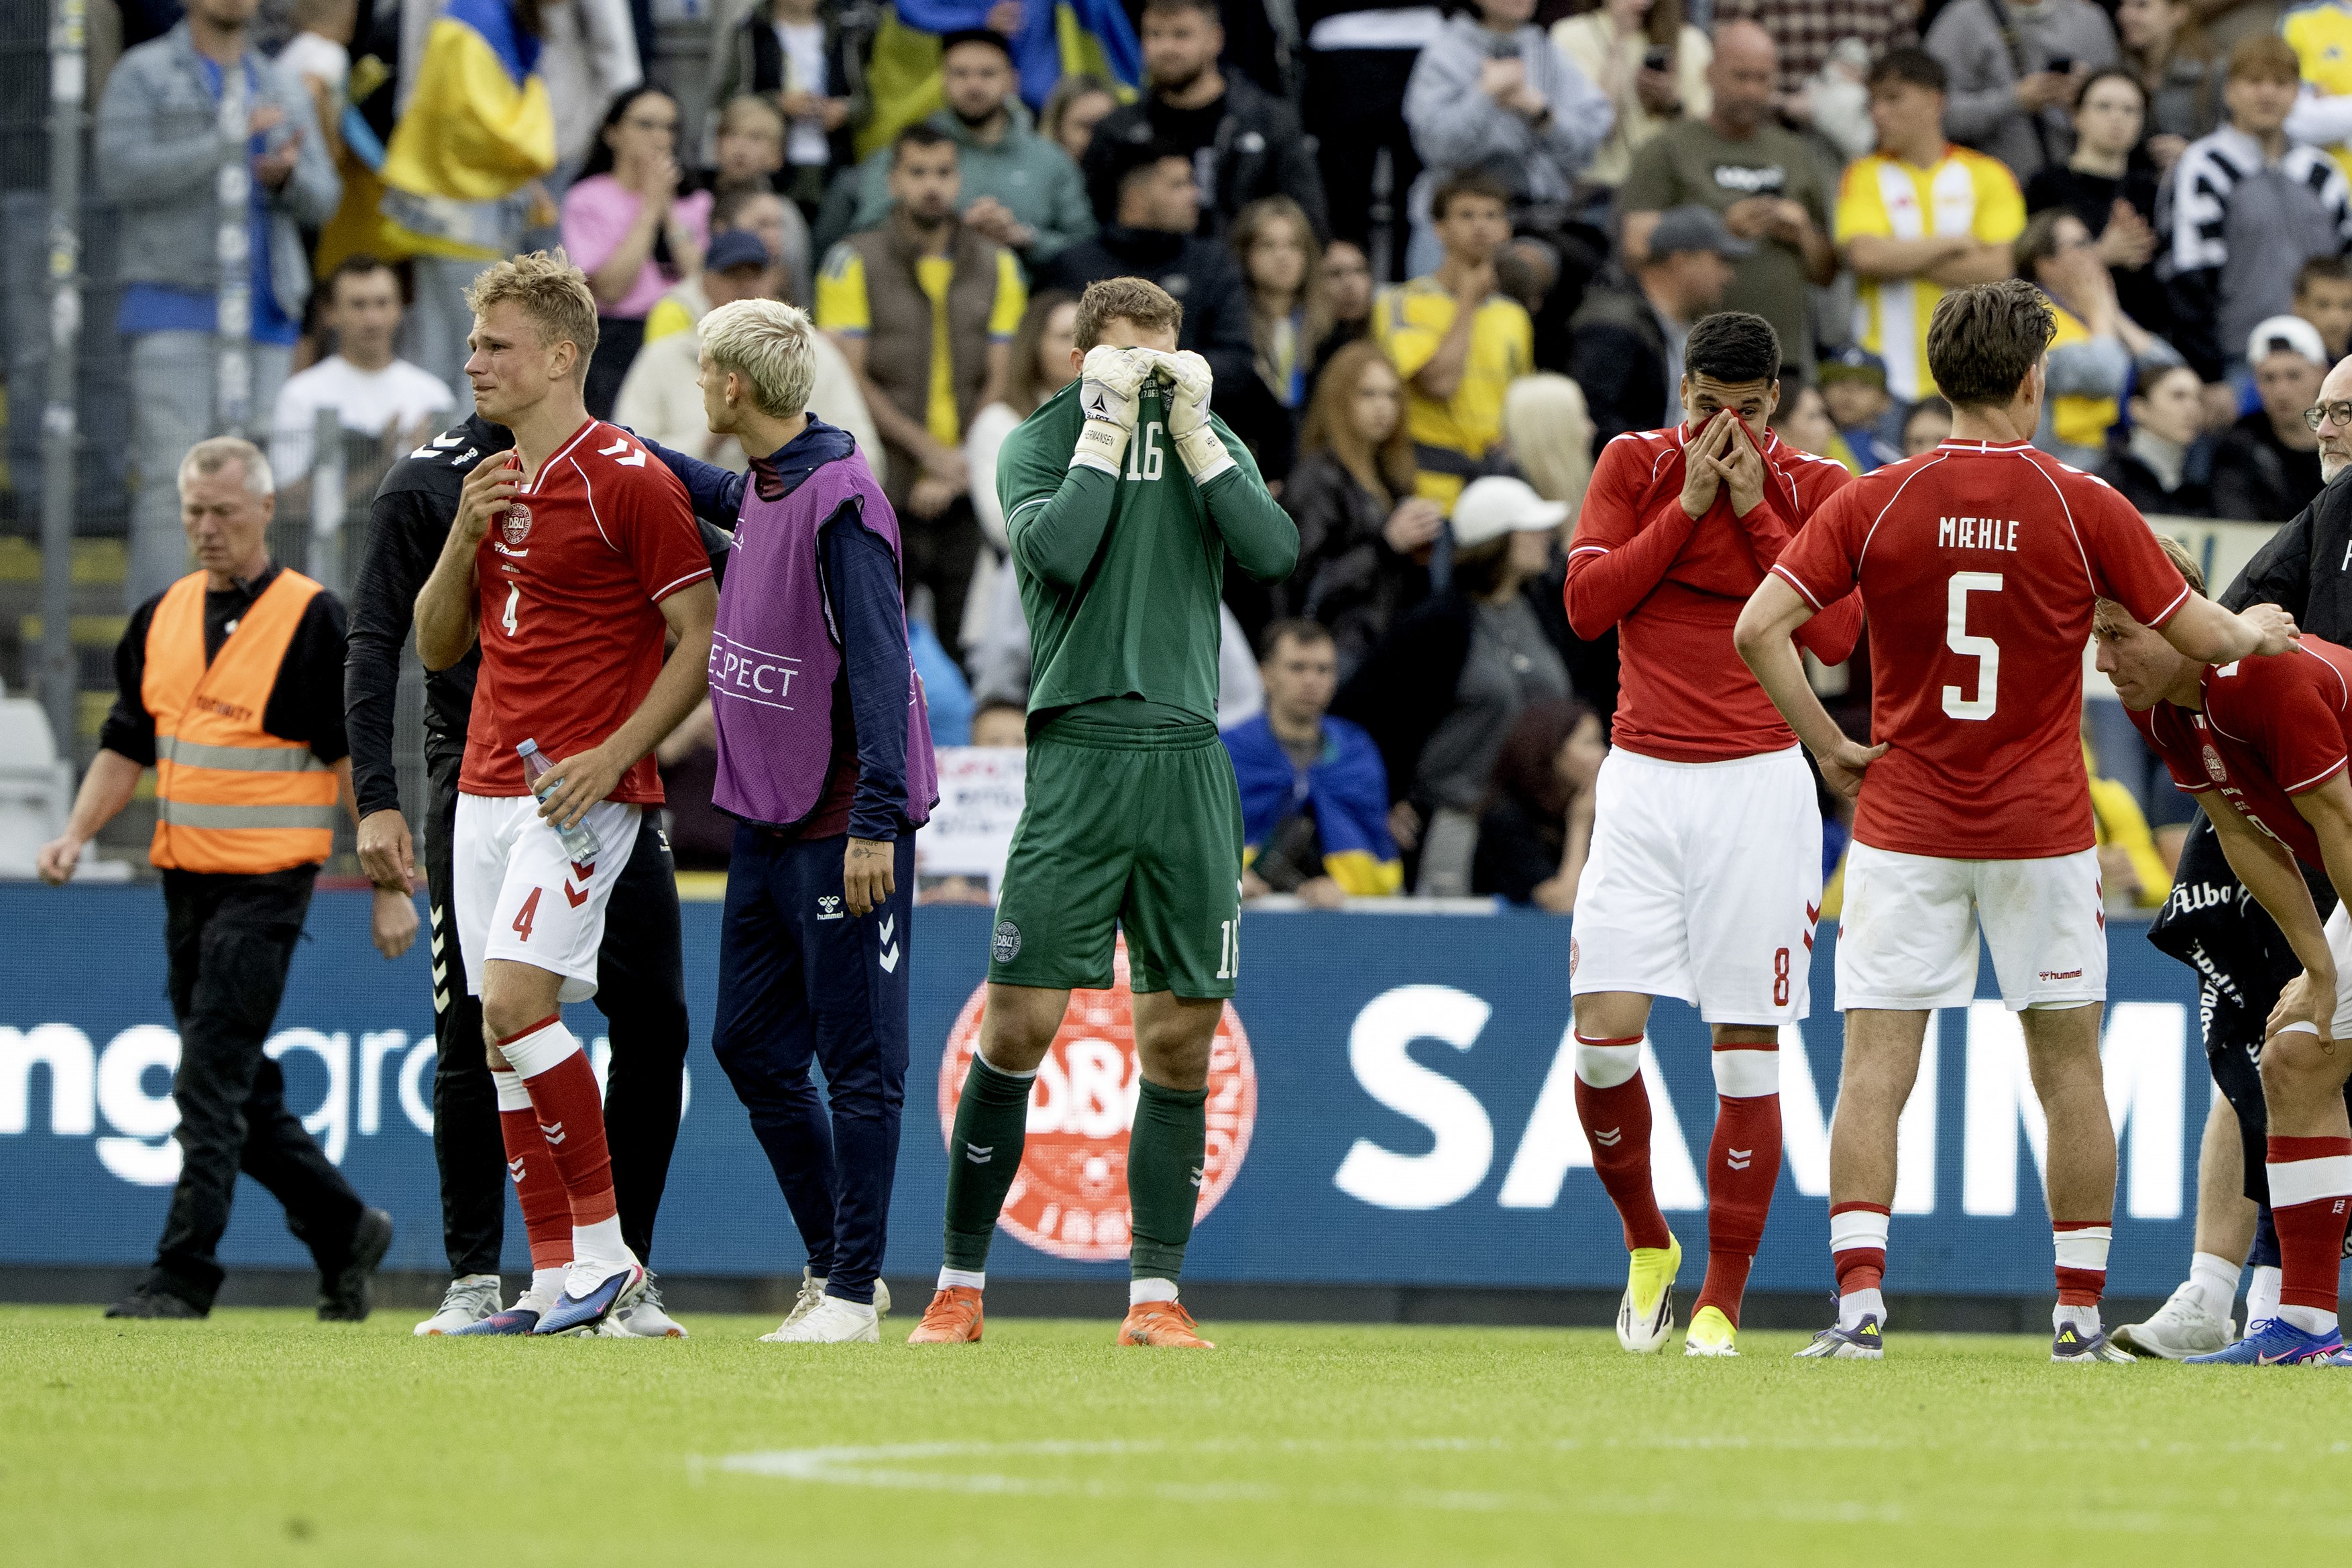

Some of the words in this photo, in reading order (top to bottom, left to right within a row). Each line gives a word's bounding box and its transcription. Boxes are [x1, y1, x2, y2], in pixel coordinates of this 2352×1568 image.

[1084, 429, 1116, 447] ERMANSEN
[1126, 421, 1164, 481] 16
[1938, 516, 2020, 551] MÆHLE
[502, 580, 520, 636] 4
[1942, 571, 2004, 714] 5
[512, 886, 543, 942] 4
[817, 911, 844, 920] hummel
[997, 935, 1014, 947] DBU
[1773, 947, 1790, 1007] 8
[2050, 967, 2082, 981] hummel
[1025, 1038, 1141, 1139] DB
